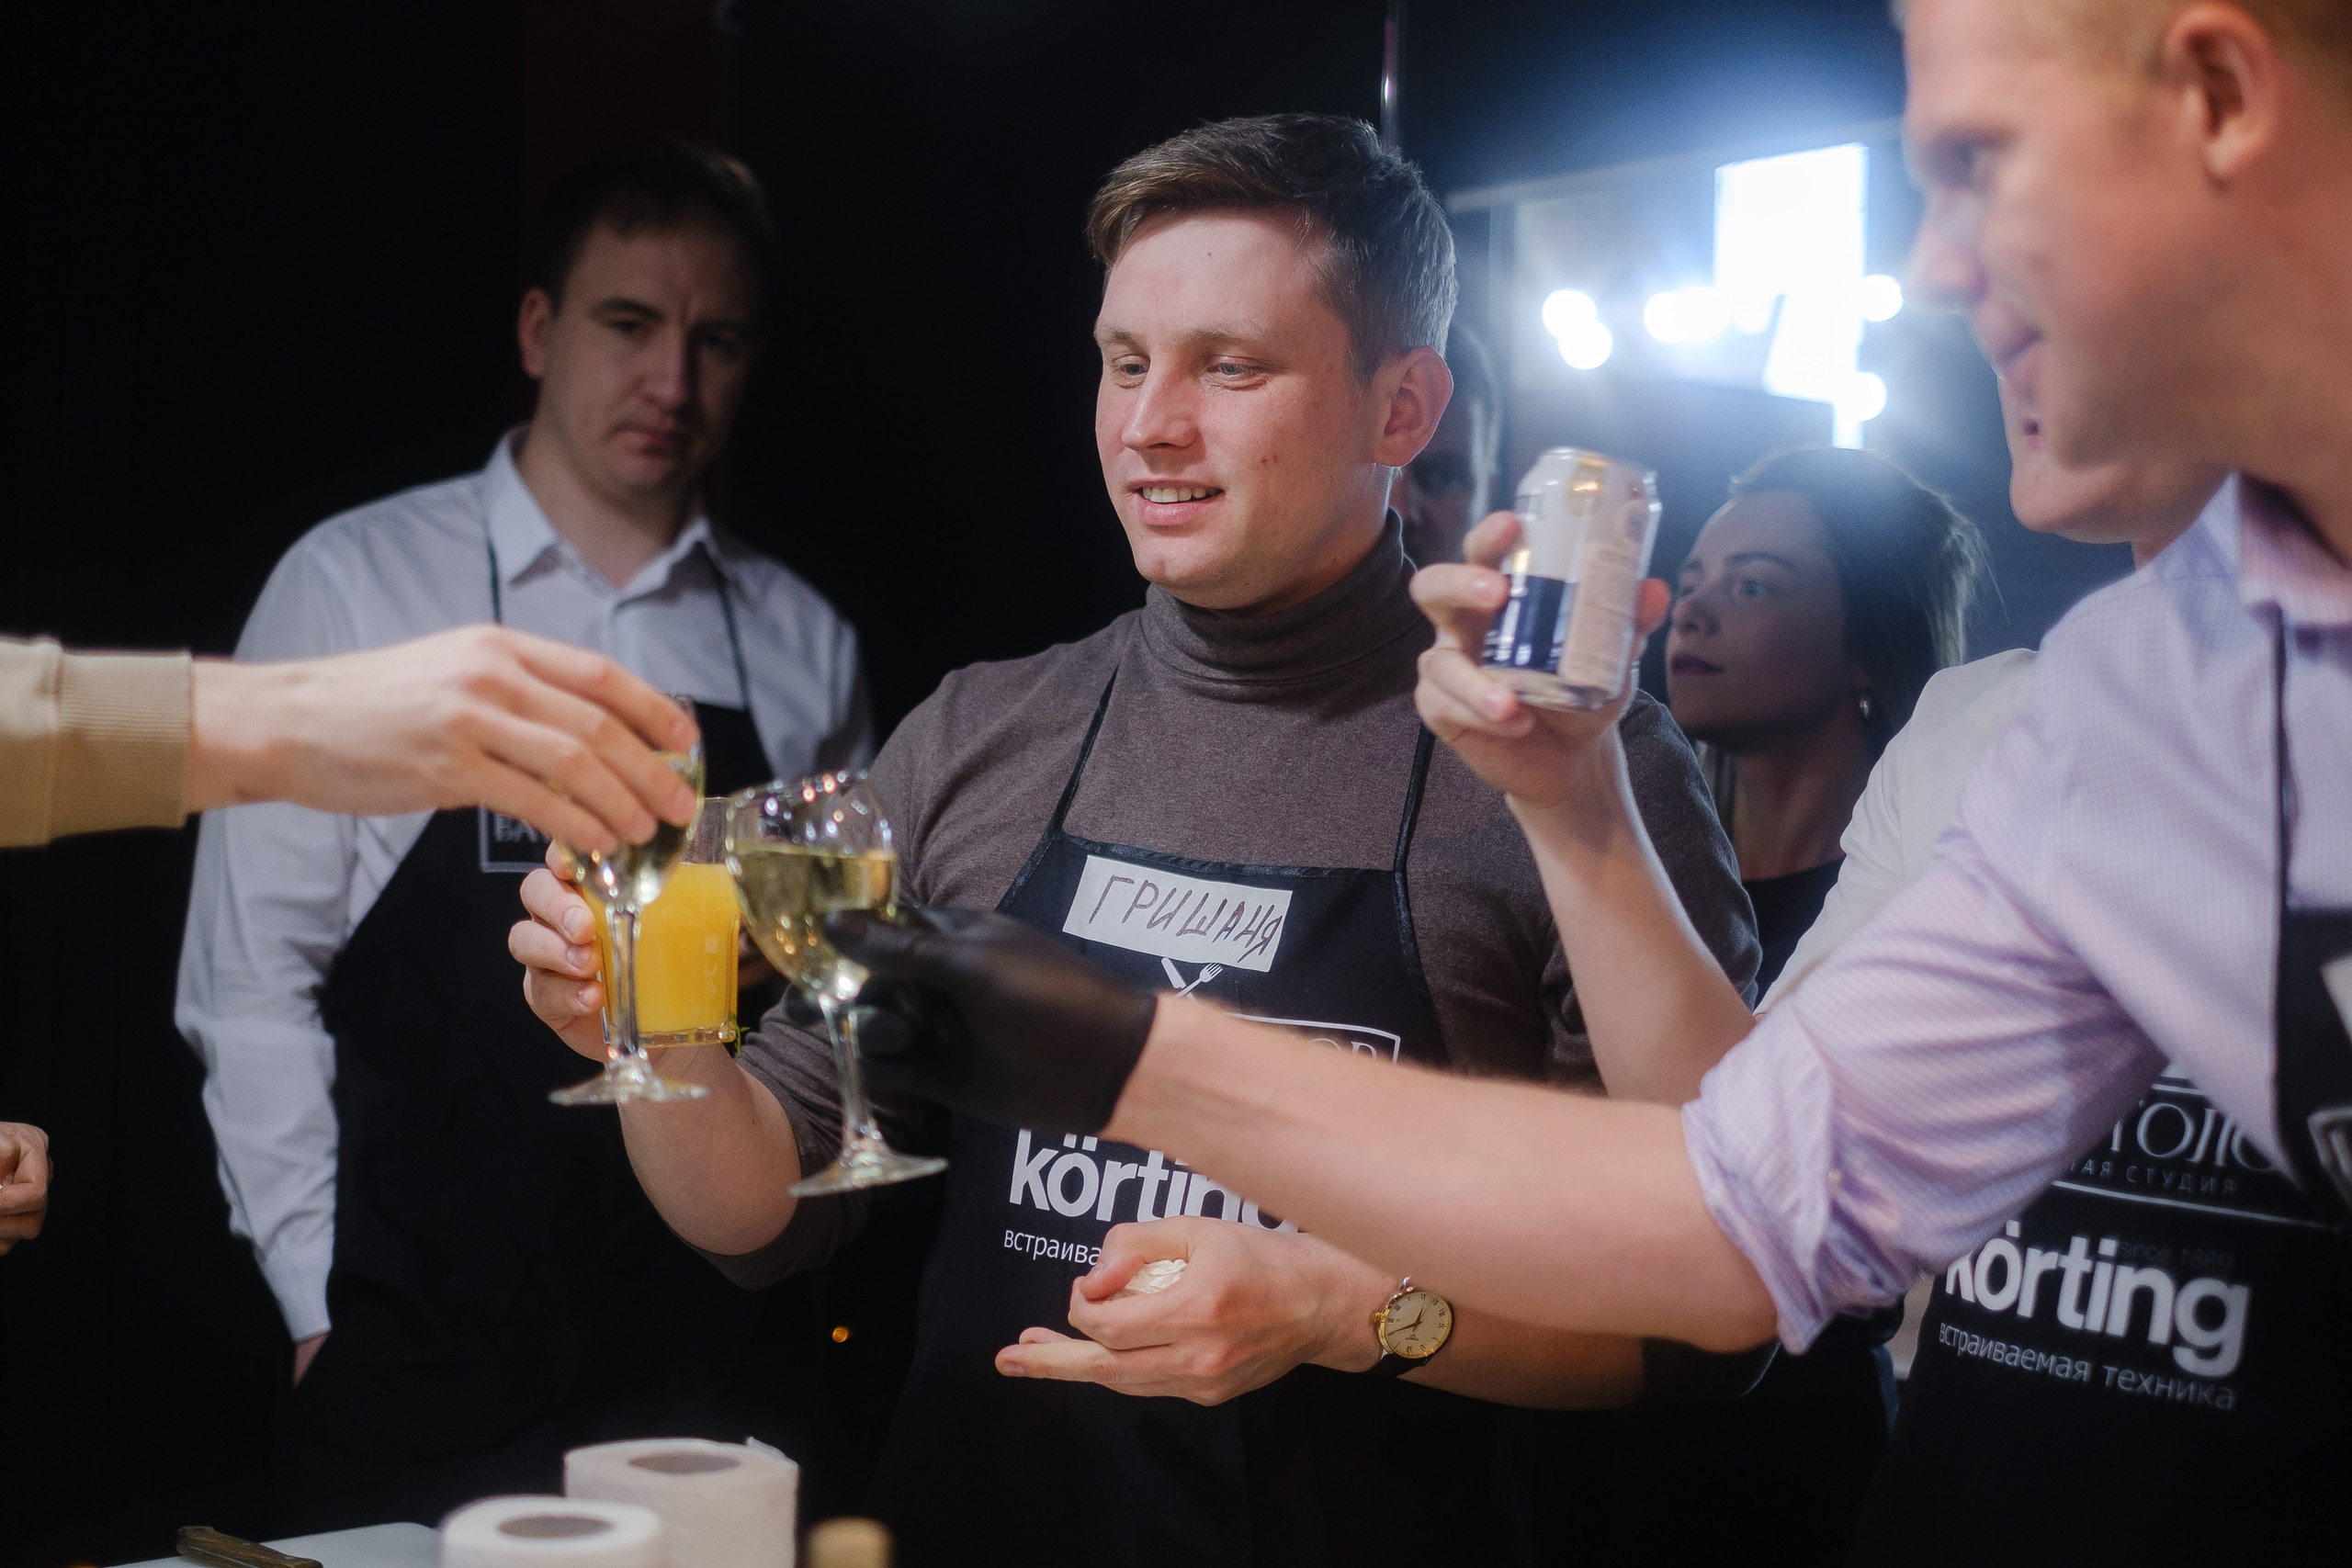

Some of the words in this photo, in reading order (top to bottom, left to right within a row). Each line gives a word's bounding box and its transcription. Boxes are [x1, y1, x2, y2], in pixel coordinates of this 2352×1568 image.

[1089, 874, 1283, 964] ГРИШАНЯ
[1010, 1128, 1298, 1233] körtin
[2126, 1165, 2234, 1194] СТУДИЯ
[1939, 1321, 2092, 1383] встраиваемая
[2101, 1364, 2236, 1411] техника
